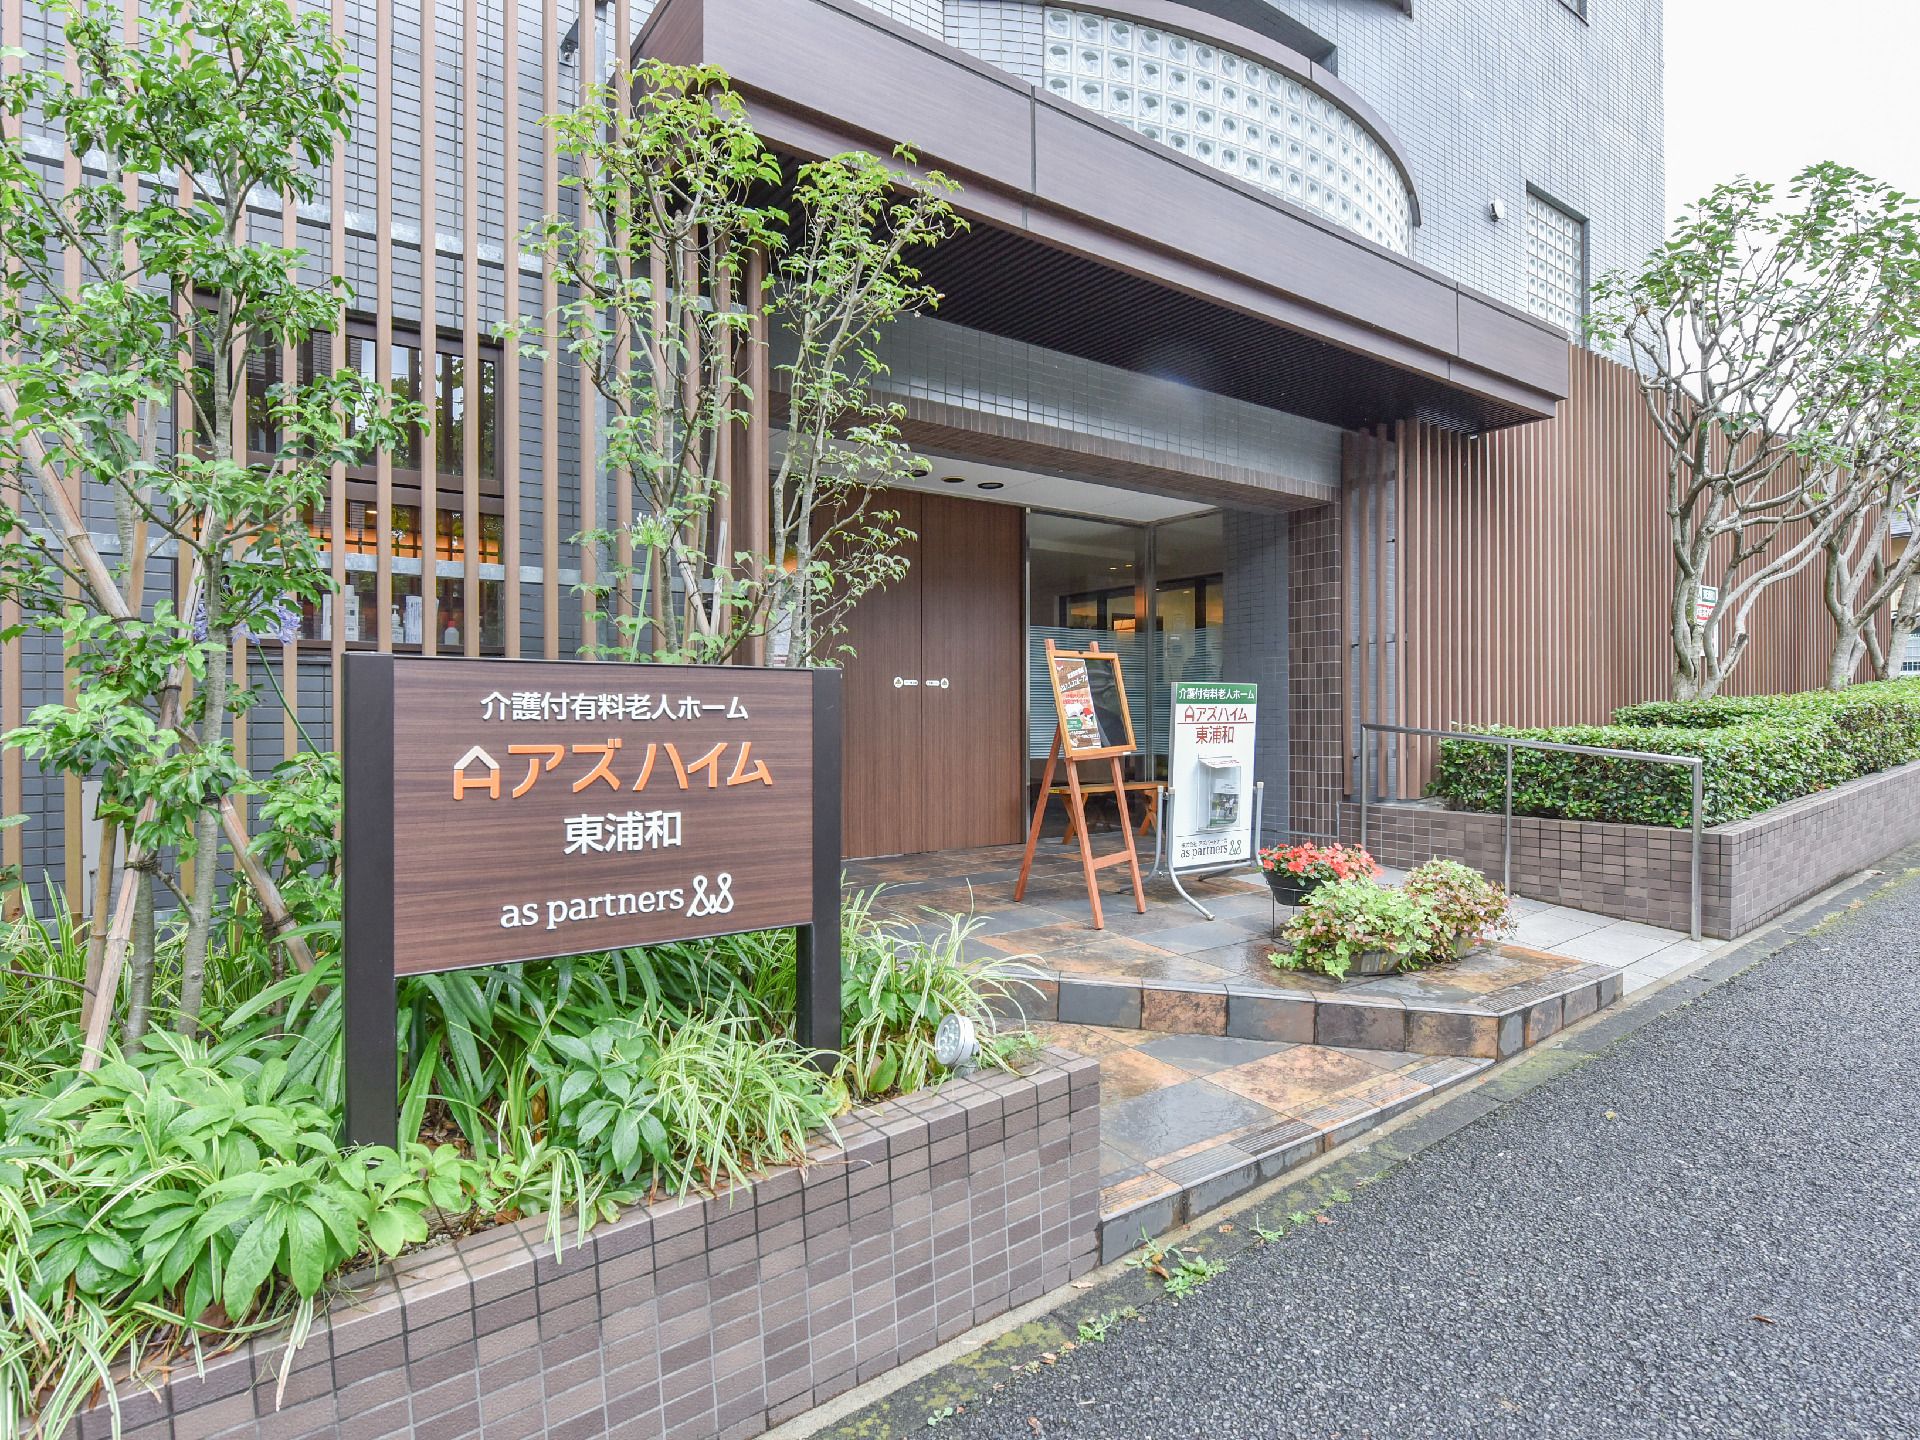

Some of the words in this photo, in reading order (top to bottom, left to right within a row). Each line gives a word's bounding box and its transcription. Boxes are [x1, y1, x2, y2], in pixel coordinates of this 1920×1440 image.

[1179, 687, 1255, 700] 介護付有料老人ホーム
[480, 691, 749, 721] 介護付有料老人ホーム
[1195, 725, 1235, 744] 東浦和
[563, 810, 682, 855] 東浦和
[1180, 849, 1191, 858] as
[1192, 844, 1228, 860] partners
[500, 903, 539, 929] as
[546, 887, 685, 930] partners
